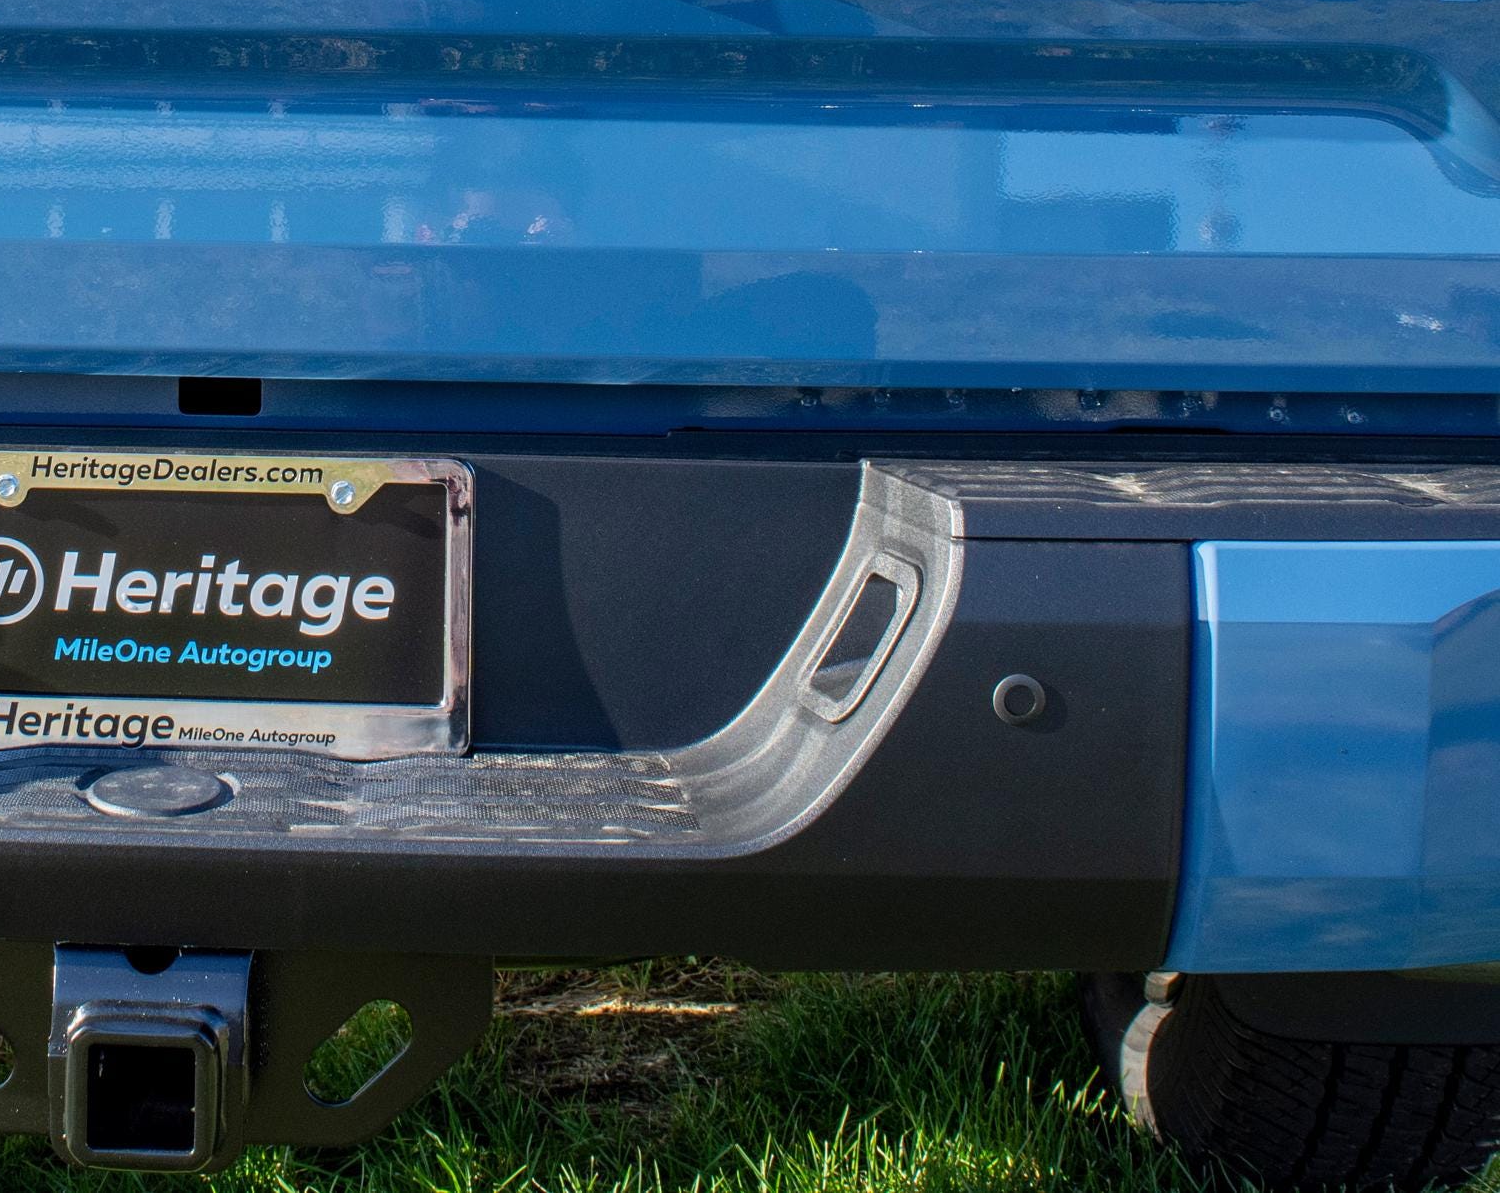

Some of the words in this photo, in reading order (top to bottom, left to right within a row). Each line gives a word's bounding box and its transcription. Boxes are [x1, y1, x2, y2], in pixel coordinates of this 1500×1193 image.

[30, 455, 324, 485] HeritageDealers.com
[54, 551, 395, 636] Heritage
[53, 637, 171, 664] MileOne
[178, 641, 332, 674] Autogroup
[179, 726, 245, 743] MileOne
[248, 728, 336, 747] Autogroup
